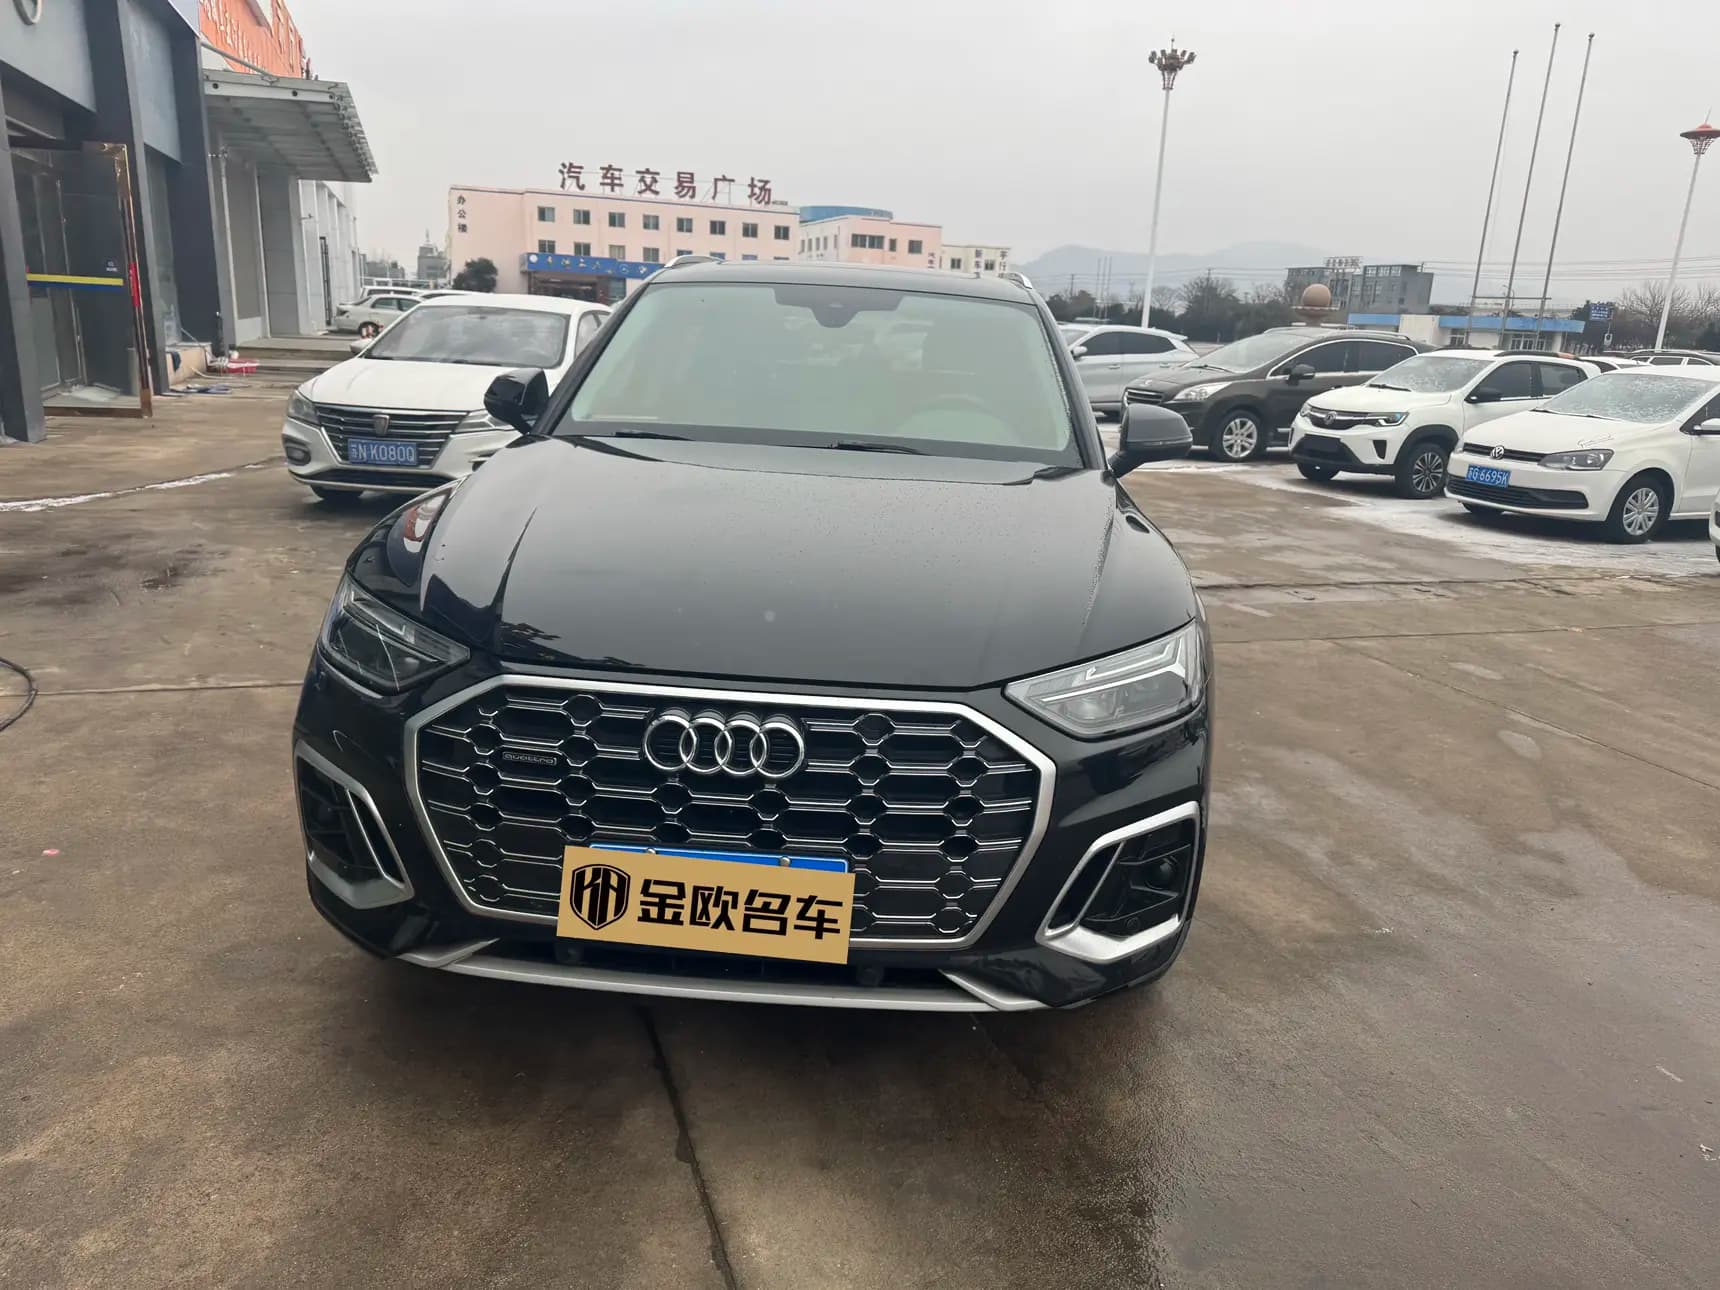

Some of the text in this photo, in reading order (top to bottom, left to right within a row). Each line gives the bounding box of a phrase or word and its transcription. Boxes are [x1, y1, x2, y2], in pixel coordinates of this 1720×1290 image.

[558, 162, 773, 205] 汽车交易广场
[637, 878, 844, 940] 金欧名车
